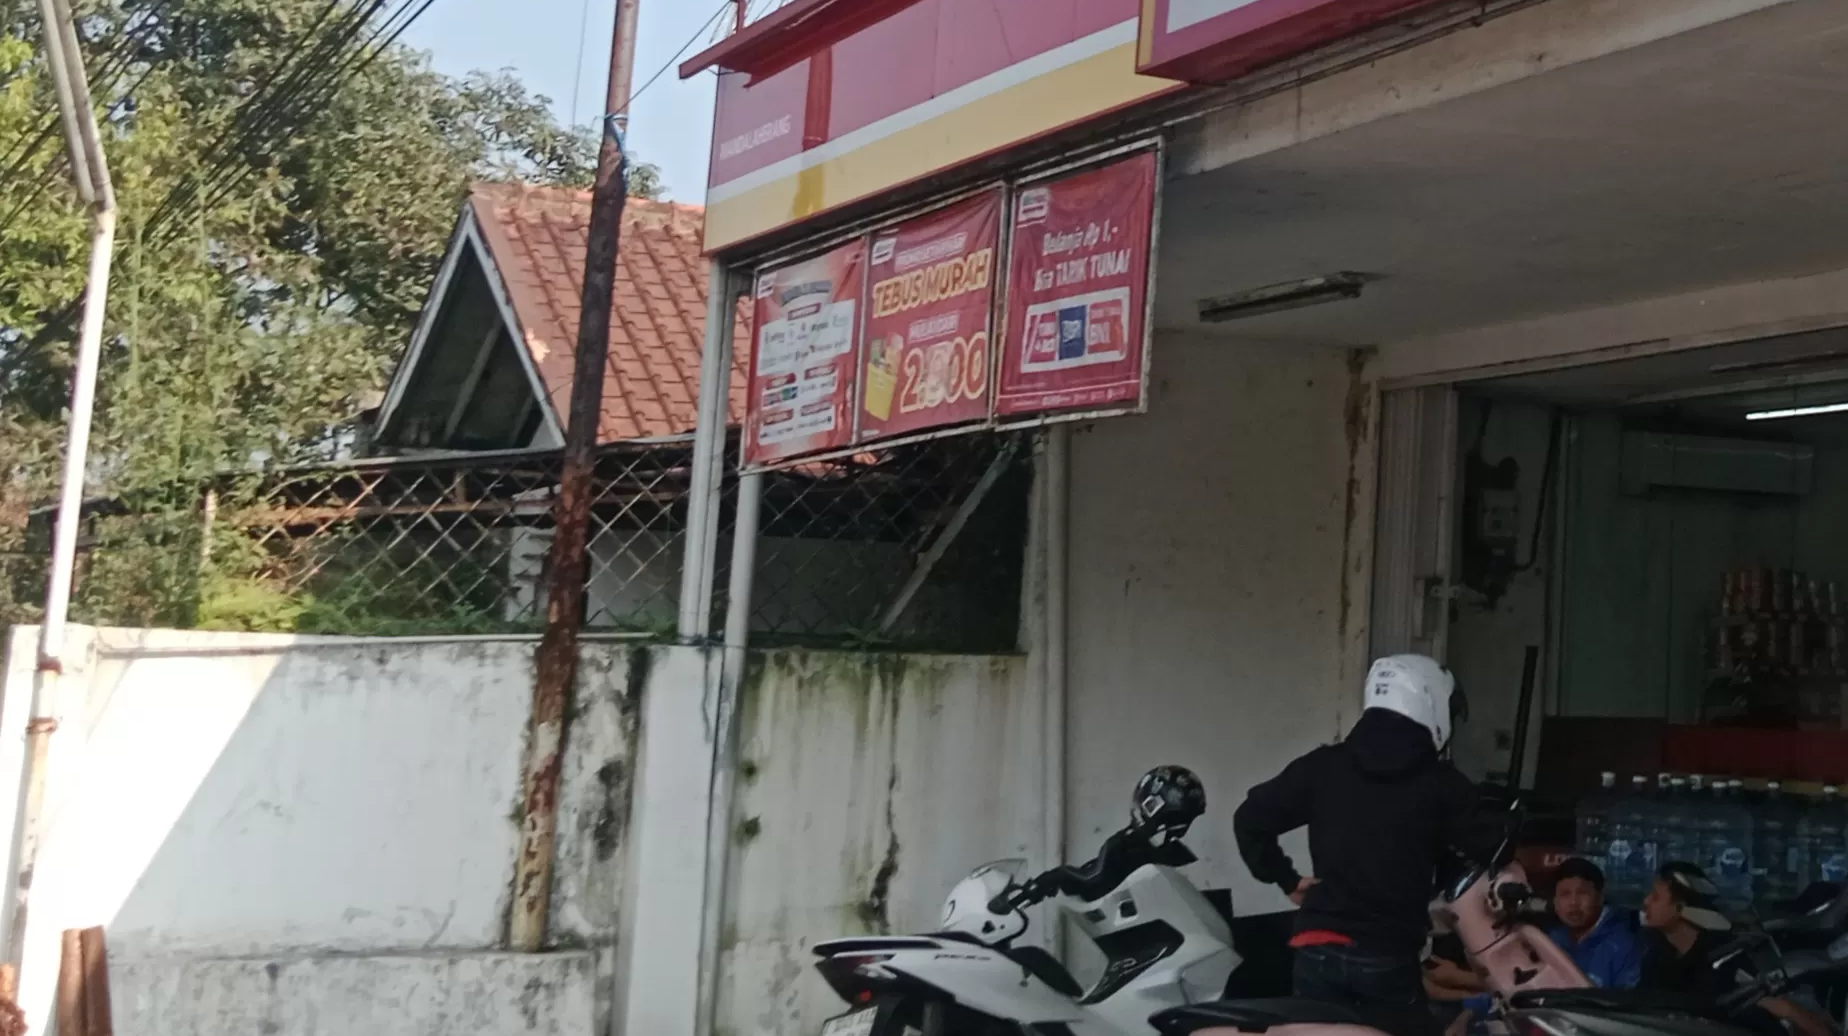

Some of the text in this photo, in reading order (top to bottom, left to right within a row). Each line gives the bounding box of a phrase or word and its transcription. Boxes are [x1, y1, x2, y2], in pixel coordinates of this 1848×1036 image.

[872, 268, 925, 319] TEBUS
[921, 247, 993, 306] MURAH
[1089, 248, 1132, 278] TUNAI
